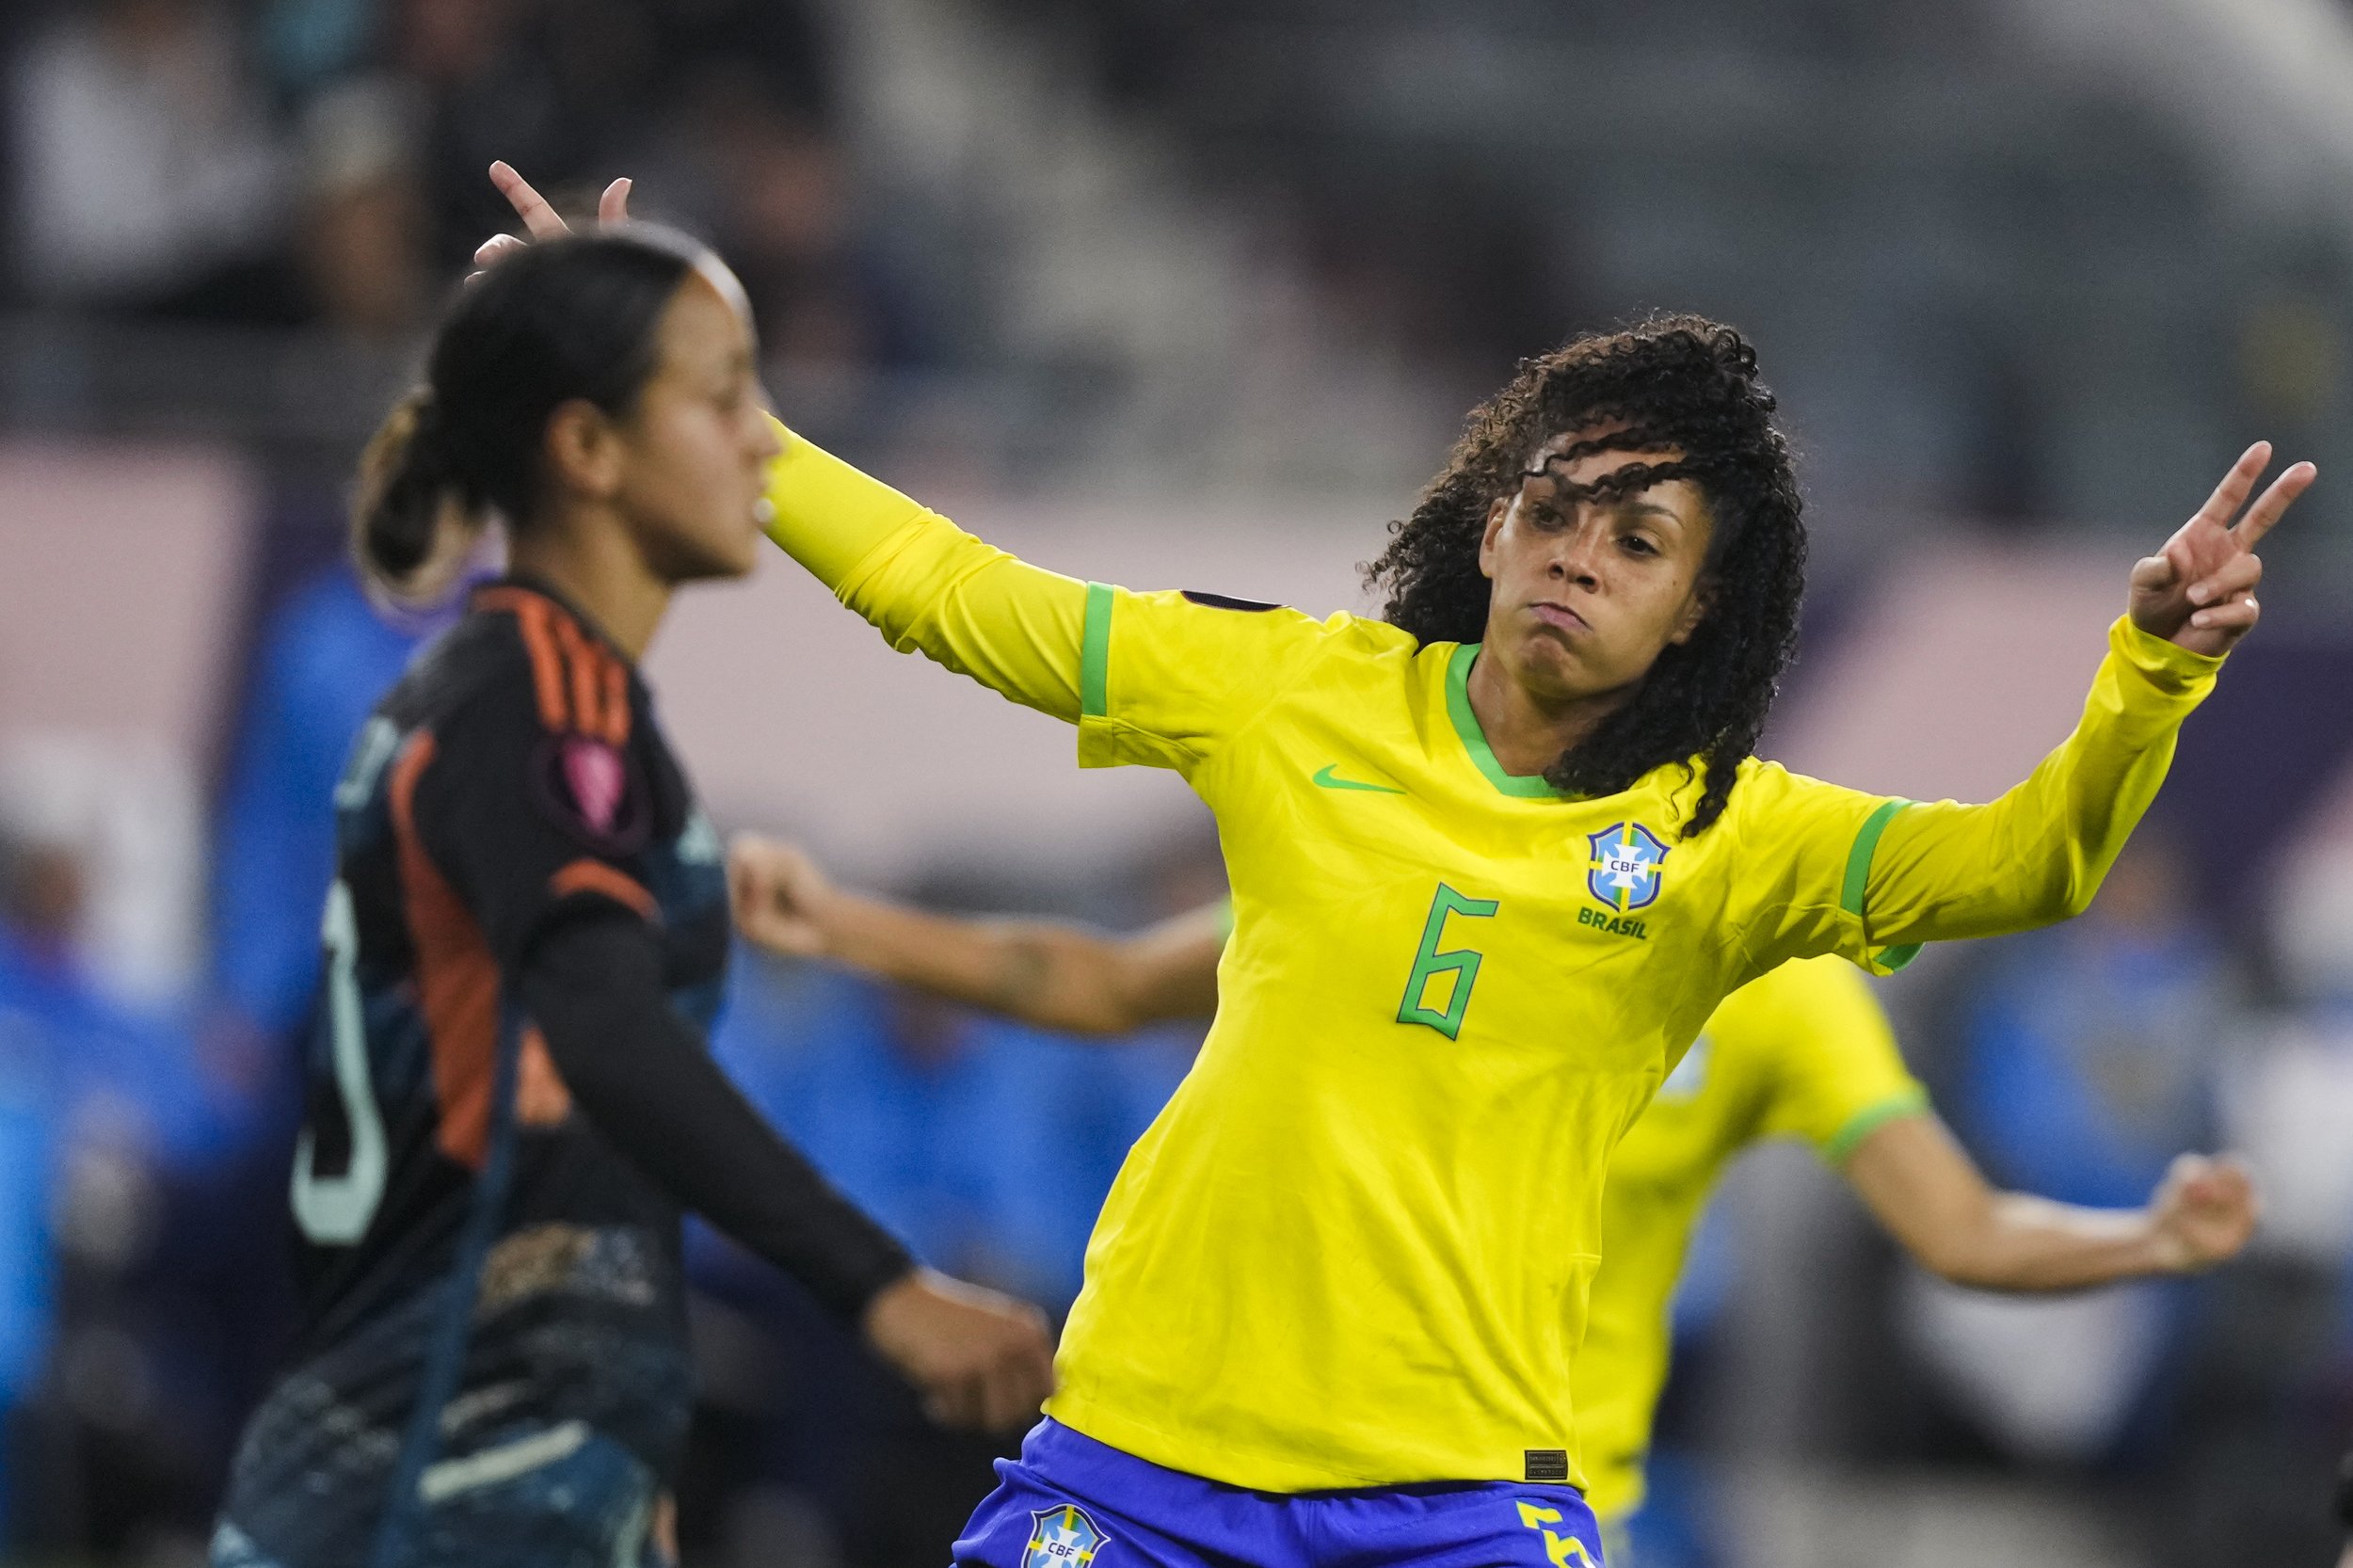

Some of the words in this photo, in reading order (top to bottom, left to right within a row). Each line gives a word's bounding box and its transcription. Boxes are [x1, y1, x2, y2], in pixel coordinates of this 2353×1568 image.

[1610, 860, 1640, 873] CBF
[1577, 906, 1647, 940] BRASIL
[1396, 881, 1499, 1042] 6
[1048, 1542, 1075, 1559] CBF
